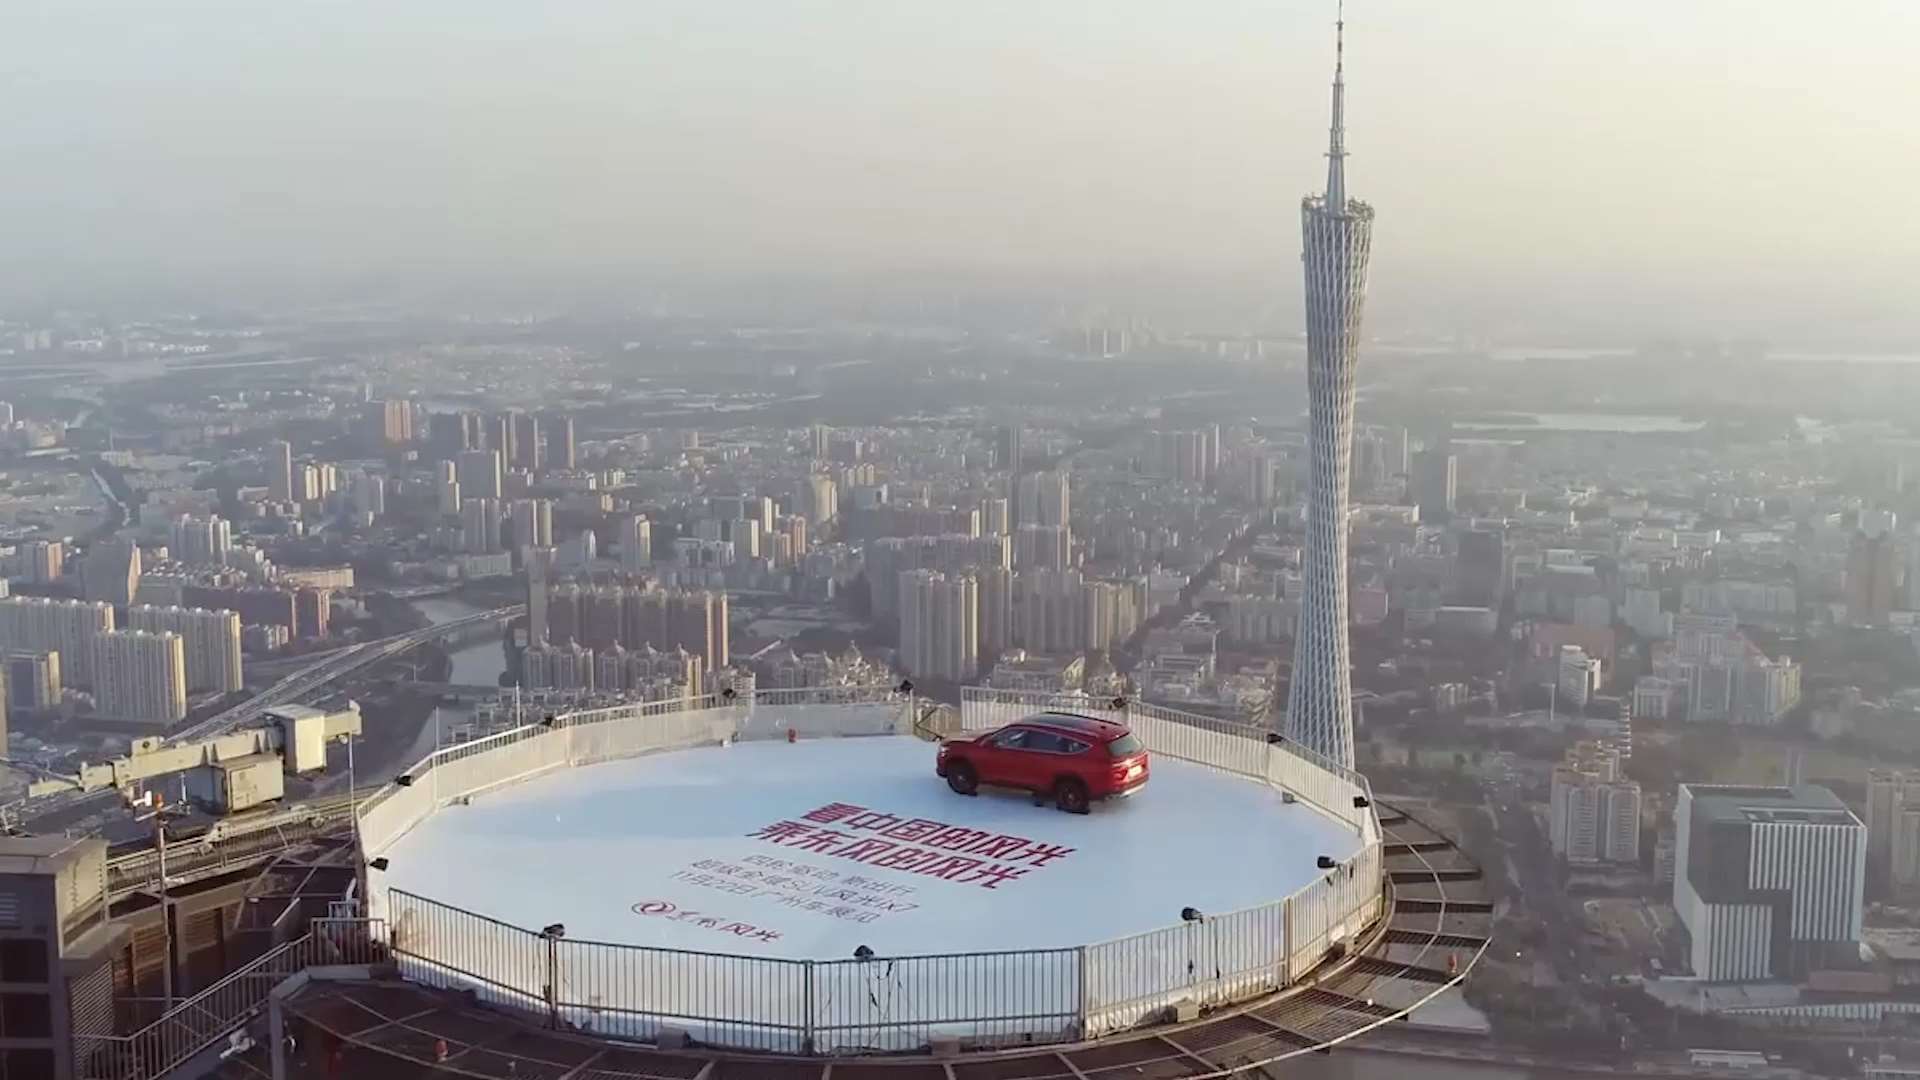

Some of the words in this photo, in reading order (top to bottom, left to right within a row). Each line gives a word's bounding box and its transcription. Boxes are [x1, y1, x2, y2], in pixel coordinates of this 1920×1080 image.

[744, 820, 1030, 888] 乘东风的风光
[800, 802, 1078, 866] 看中国的风光
